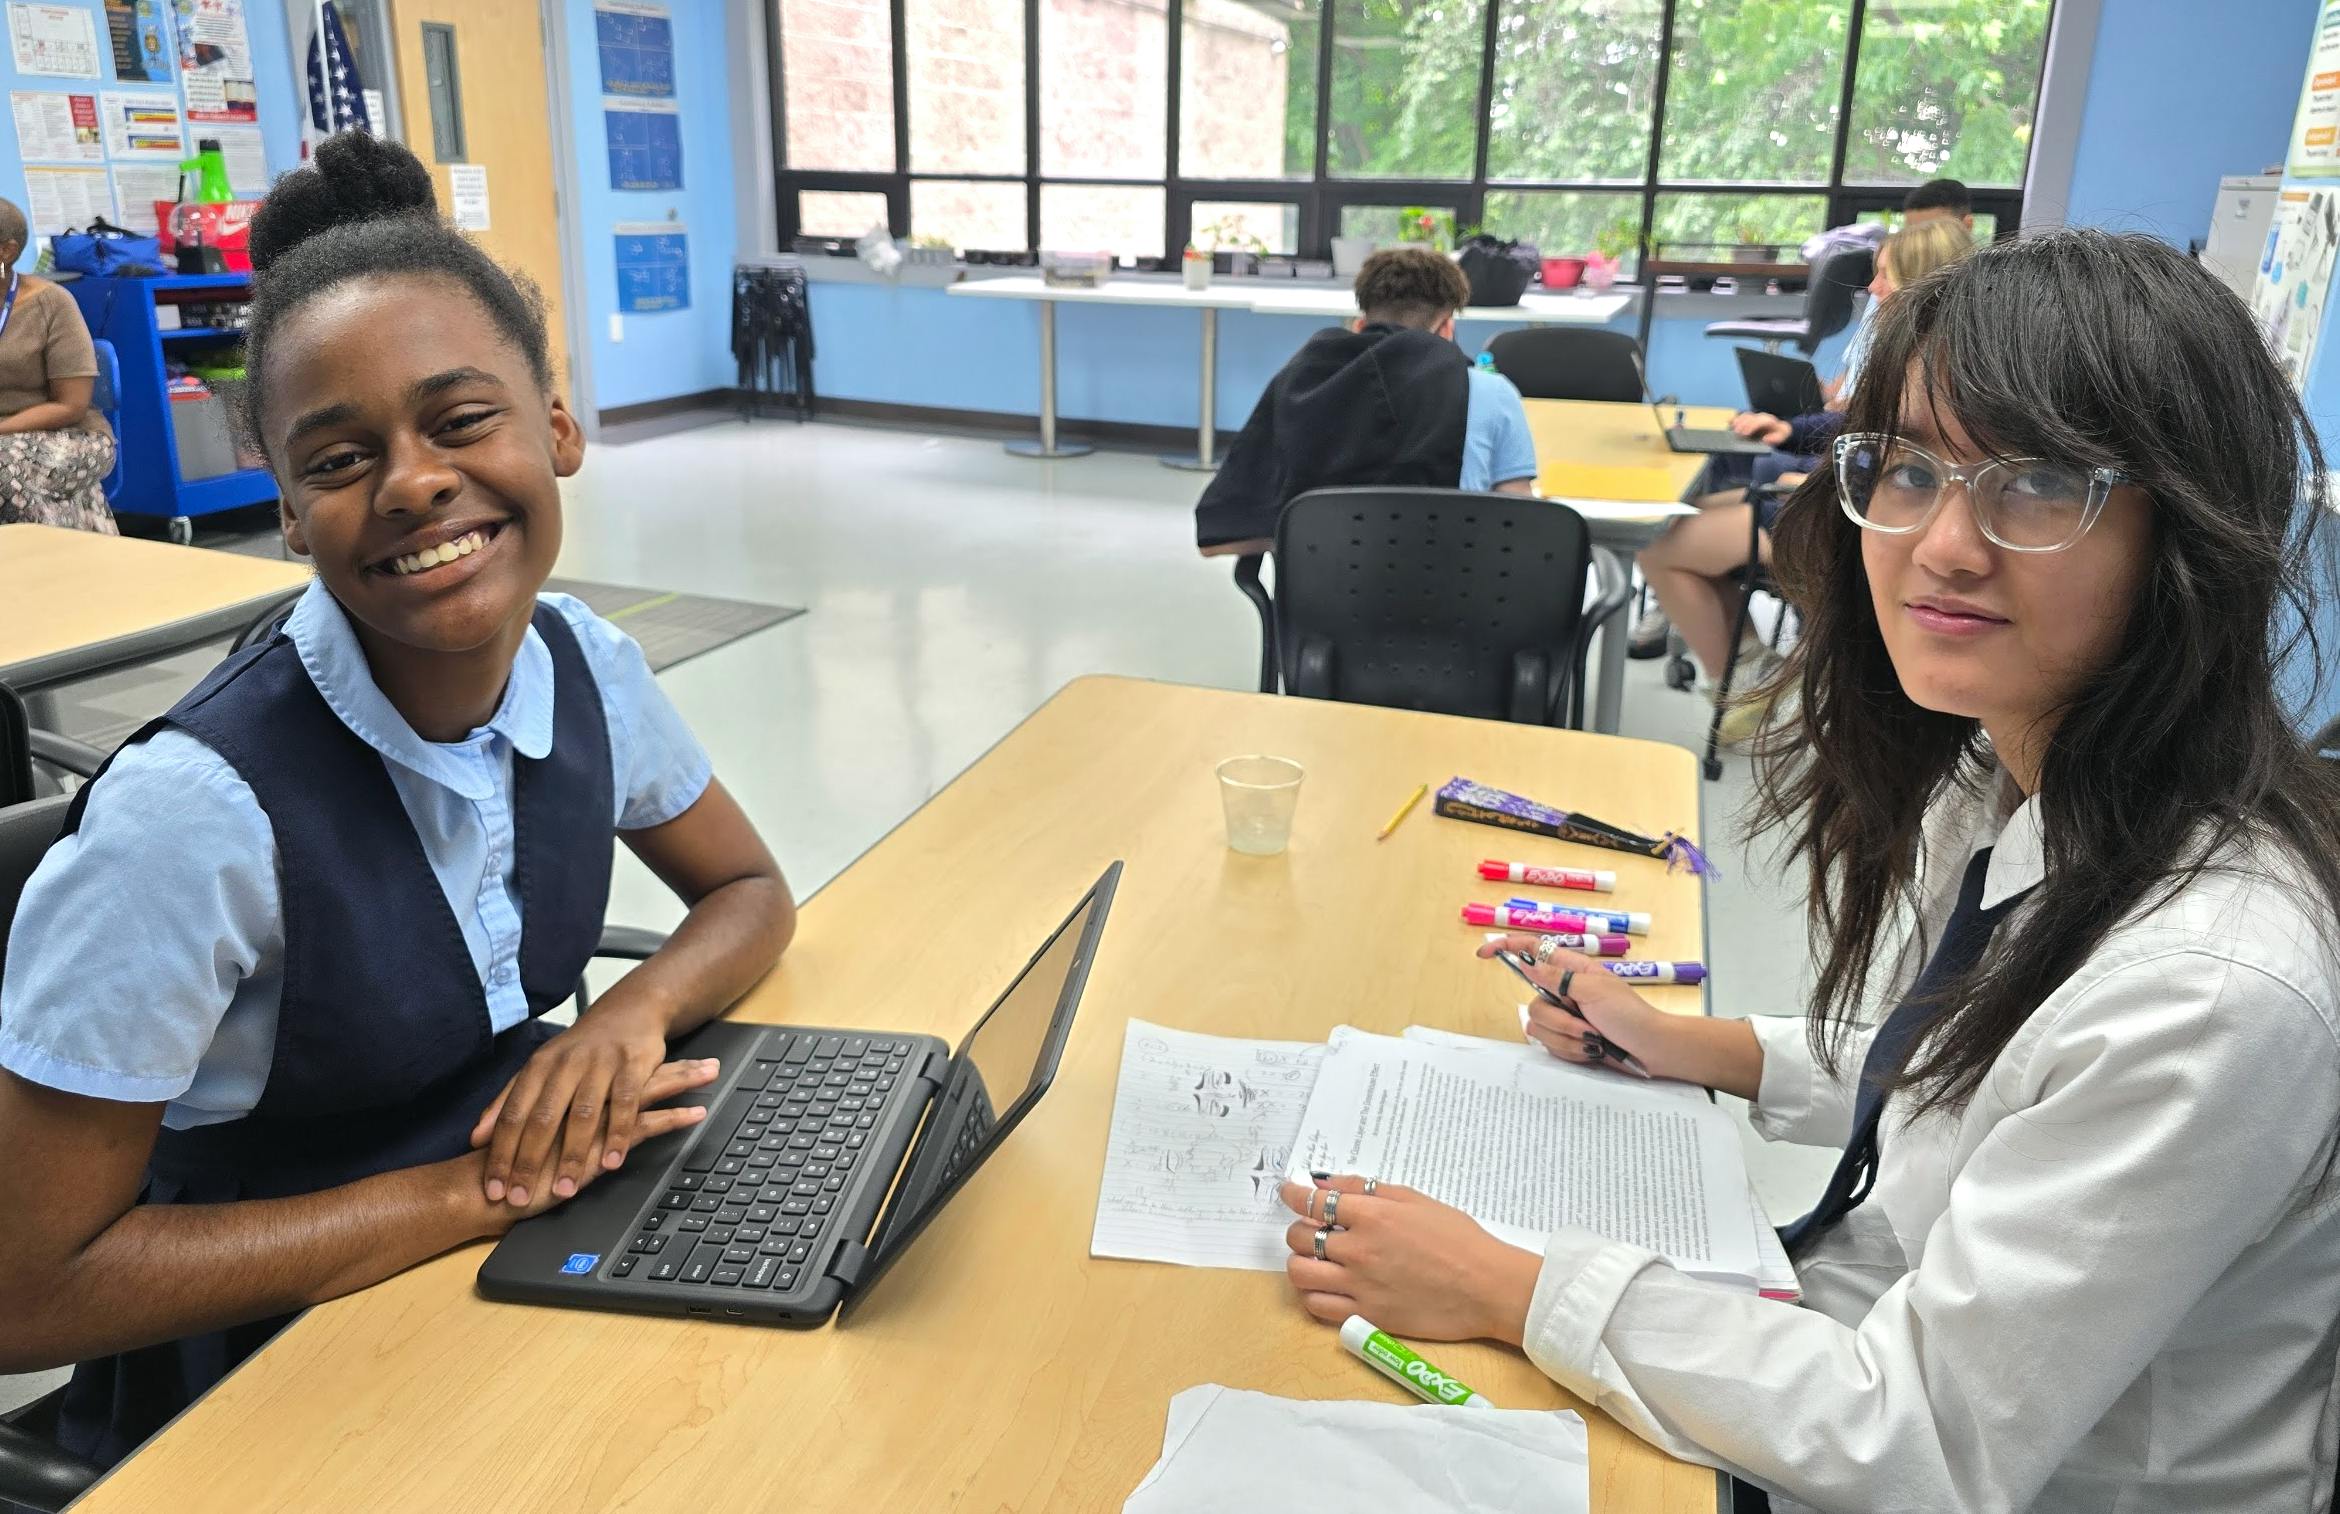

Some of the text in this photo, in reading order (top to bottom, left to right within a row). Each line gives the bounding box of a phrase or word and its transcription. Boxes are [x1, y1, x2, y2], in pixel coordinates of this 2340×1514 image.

[1526, 869, 1565, 885] EXPO
[1613, 960, 1654, 978] EXPO
[660, 1264, 670, 1276] shift
[692, 1264, 703, 1279] enter
[753, 1258, 772, 1283] backspace
[1406, 1361, 1468, 1401] EXPO
